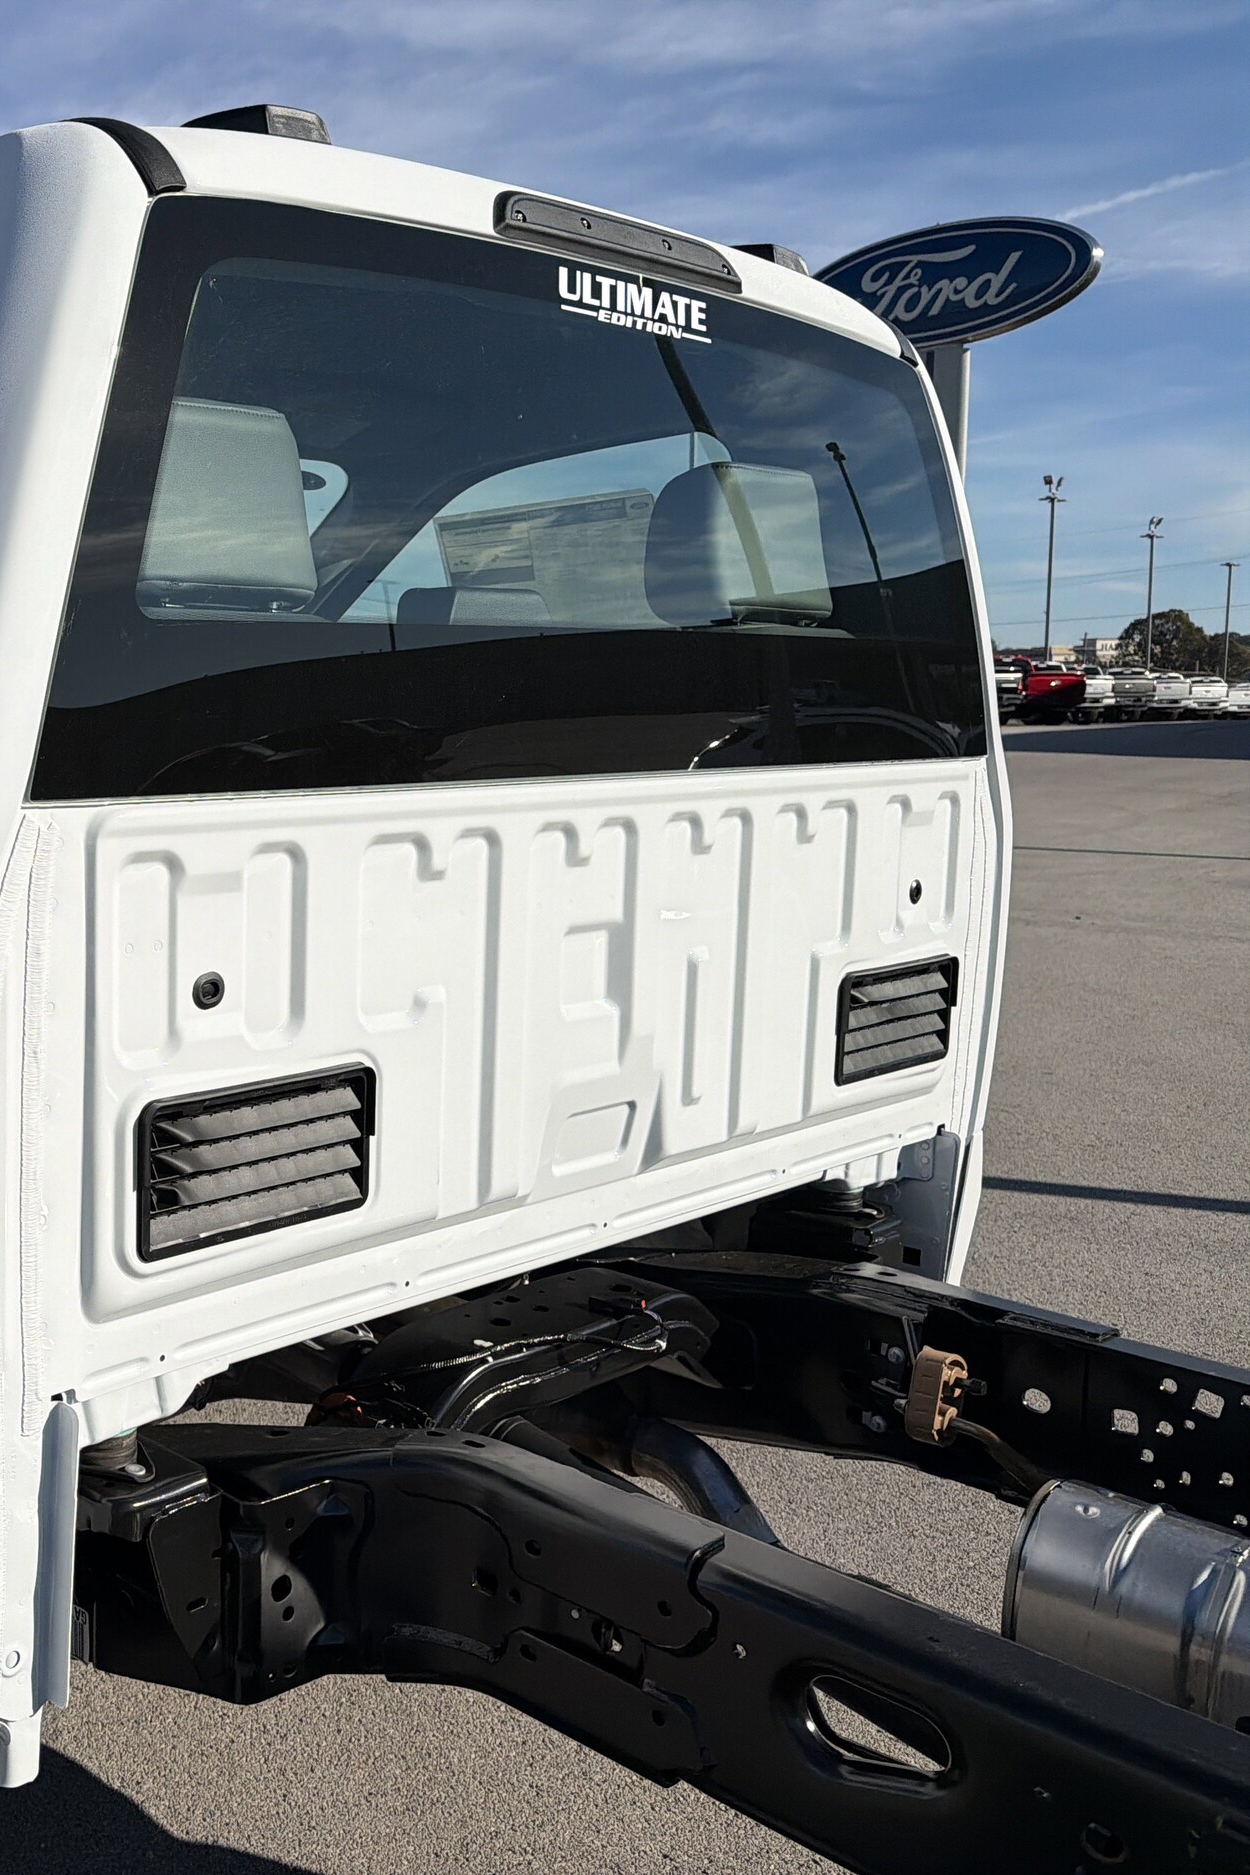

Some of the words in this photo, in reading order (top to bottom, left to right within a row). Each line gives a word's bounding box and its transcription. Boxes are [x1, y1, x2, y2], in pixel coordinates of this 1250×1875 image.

[558, 266, 707, 332] ULTIMATE
[861, 245, 1023, 321] Ford
[597, 309, 683, 339] EDITION
